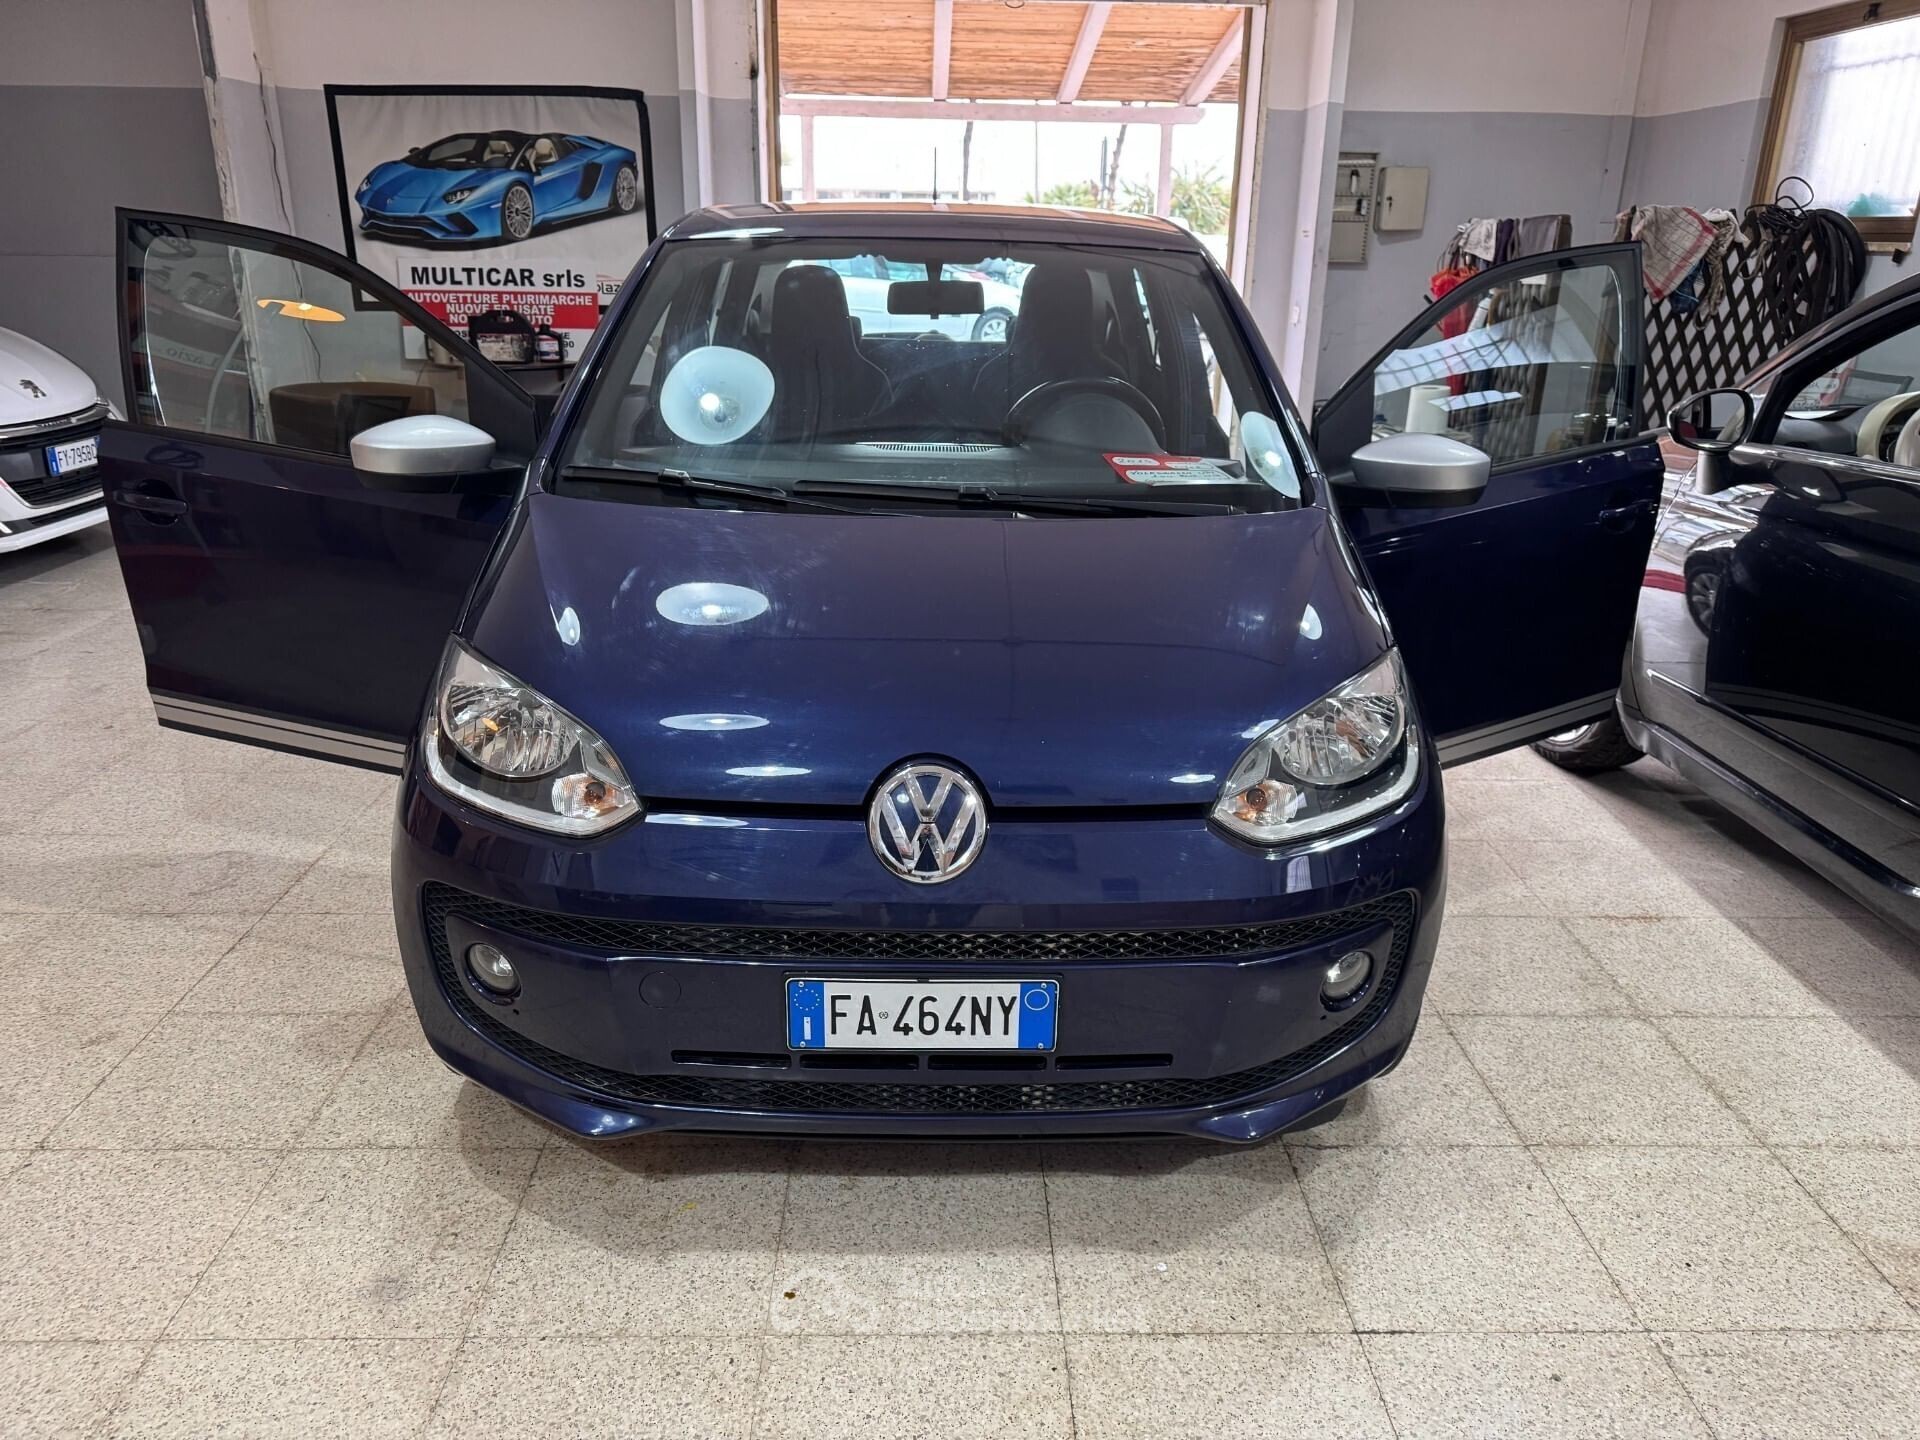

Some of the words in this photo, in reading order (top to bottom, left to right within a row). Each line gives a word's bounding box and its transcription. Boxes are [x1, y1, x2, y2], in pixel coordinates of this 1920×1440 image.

[410, 266, 536, 287] MULTICAR
[542, 269, 586, 288] srls
[407, 292, 499, 304] AUTOVETTURE
[502, 294, 593, 306] PLURIMARCHE
[526, 315, 553, 325] UTO
[829, 994, 877, 1036] FA
[892, 994, 1018, 1037] 464NY
